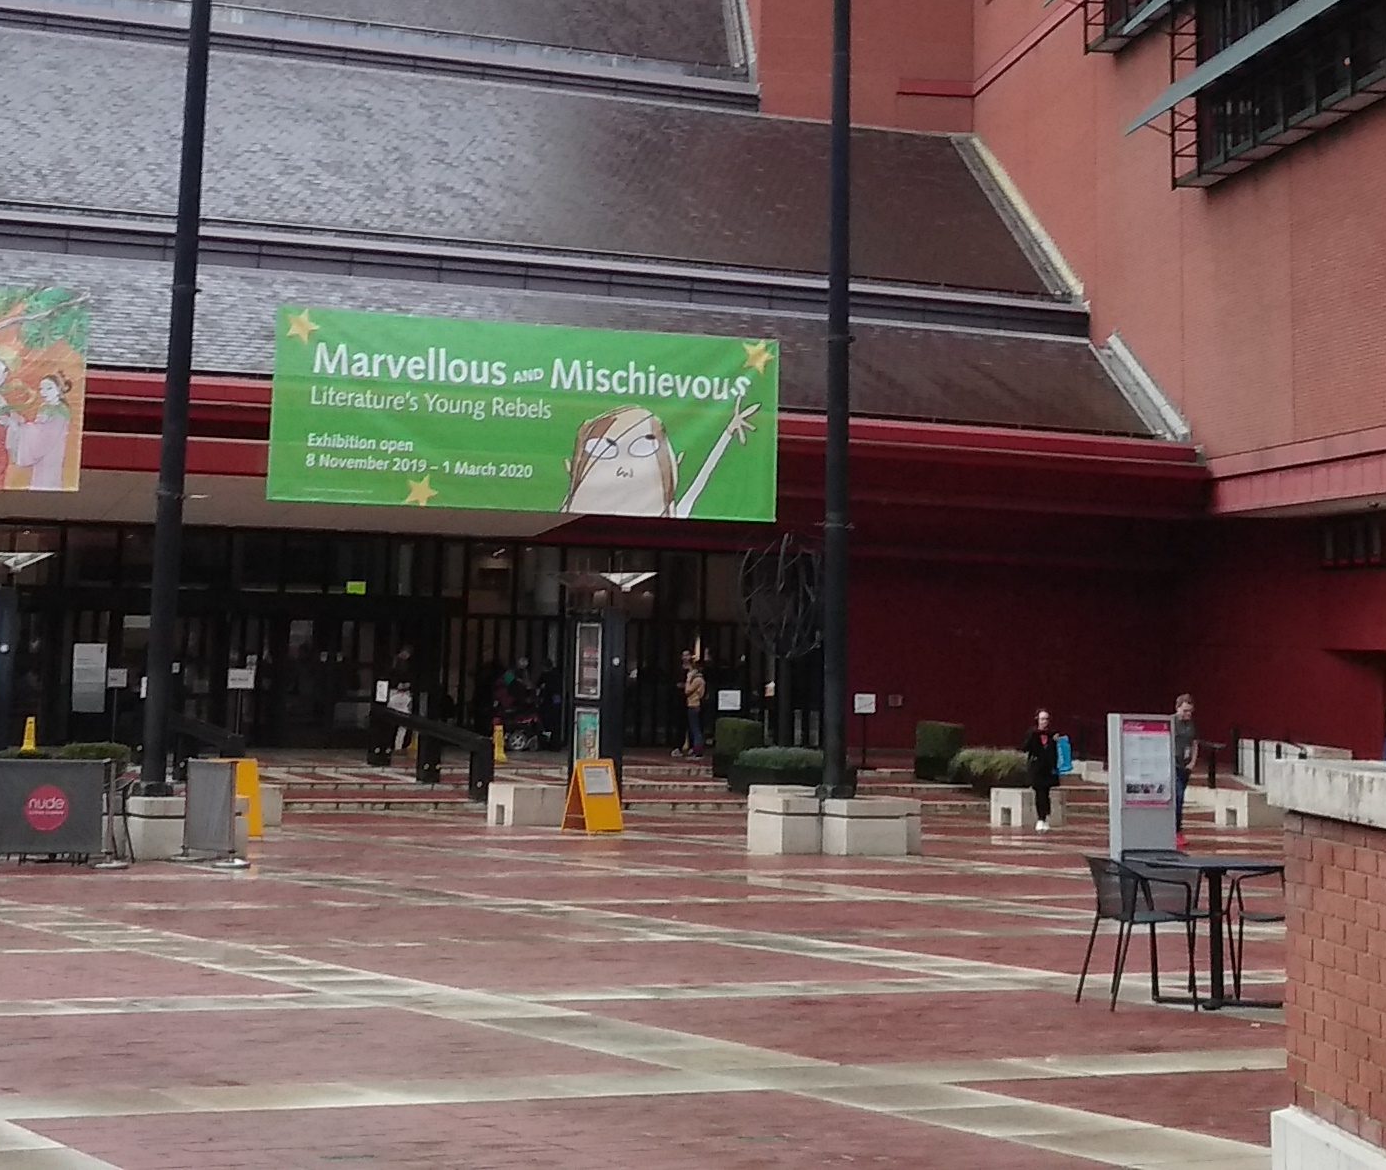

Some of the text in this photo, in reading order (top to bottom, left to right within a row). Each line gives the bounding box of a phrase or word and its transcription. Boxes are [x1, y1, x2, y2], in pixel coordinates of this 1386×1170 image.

[312, 341, 752, 401] Marvellous AND Mischievous
[311, 385, 552, 421] Literature's Young Rebels
[307, 432, 413, 454] Exhibition open
[305, 453, 314, 468] 8
[319, 454, 390, 471] November
[392, 457, 427, 473] 2019
[442, 460, 450, 473] 1
[454, 461, 497, 477] March
[499, 463, 533, 479] 2020
[28, 796, 65, 810] nude
